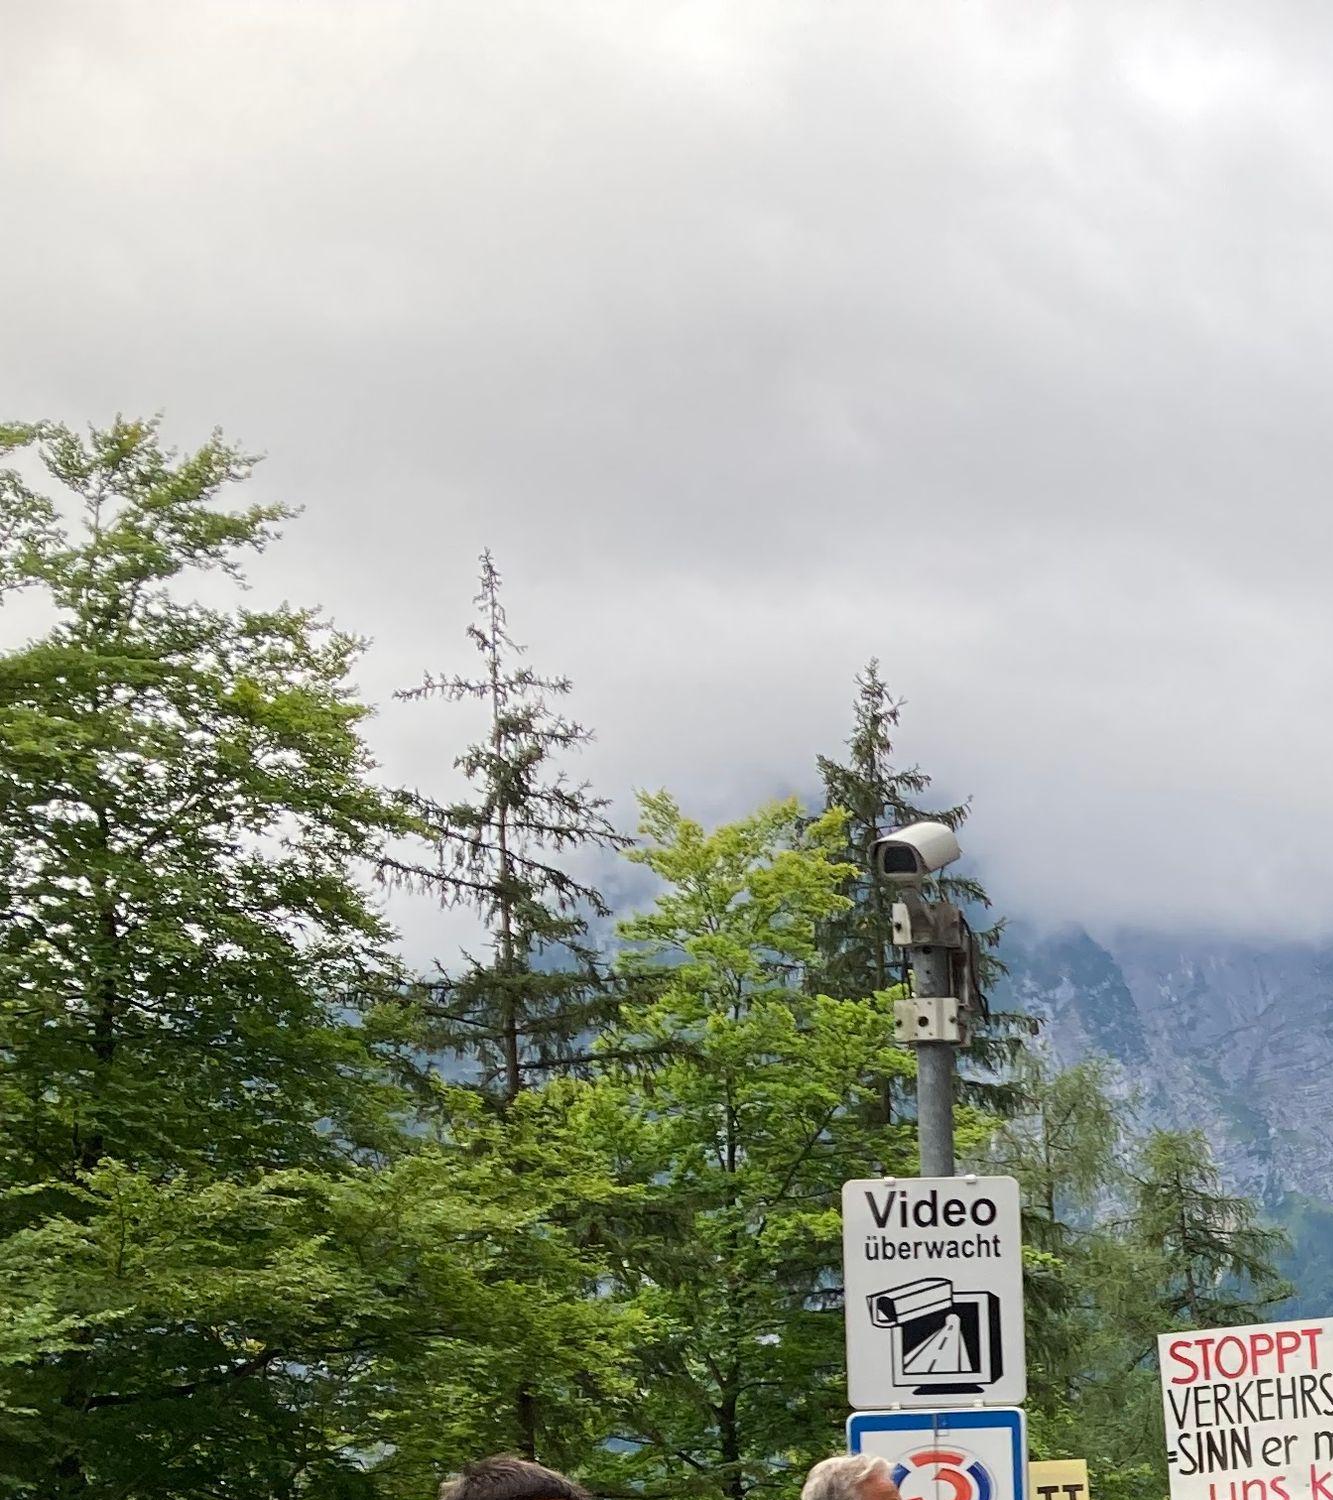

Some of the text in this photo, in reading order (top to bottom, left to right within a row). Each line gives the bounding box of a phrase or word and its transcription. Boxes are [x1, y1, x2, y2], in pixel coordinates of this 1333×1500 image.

[864, 1189, 998, 1229] Video
[864, 1234, 1002, 1261] überwacht
[1169, 1328, 1322, 1385] STOPPT
[1261, 1434, 1298, 1467] er
